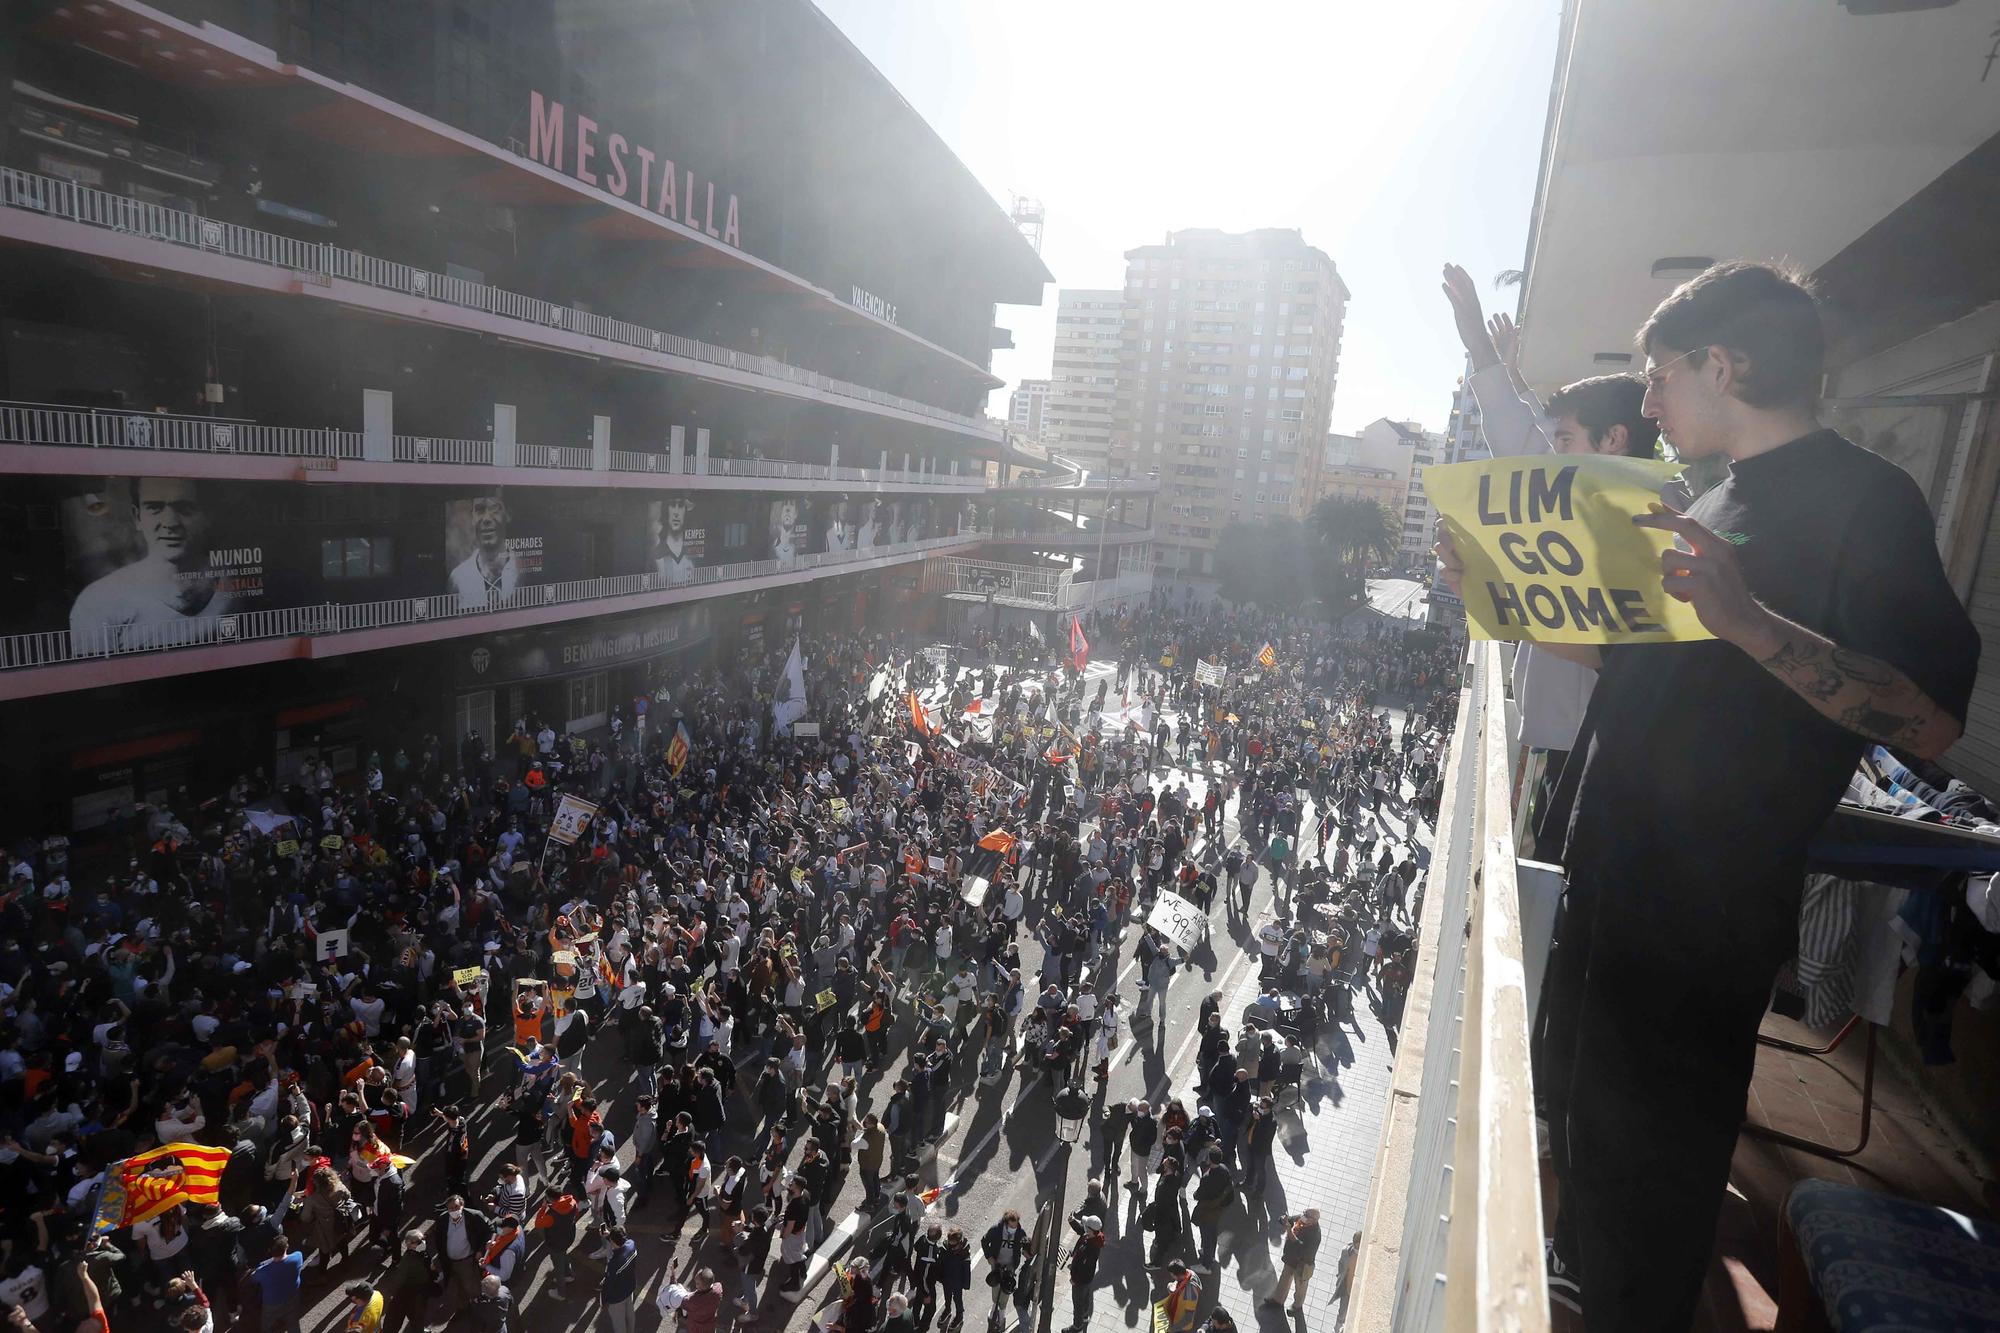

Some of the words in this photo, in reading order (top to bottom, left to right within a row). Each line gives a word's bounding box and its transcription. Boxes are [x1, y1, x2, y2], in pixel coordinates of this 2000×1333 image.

[528, 90, 741, 249] MESTALLA
[852, 284, 885, 318] VALENCIA
[1478, 465, 1579, 526] LIM
[684, 528, 705, 540] KEMPES
[209, 547, 262, 567] MUNDO
[1499, 530, 1585, 577] GO
[226, 568, 239, 577] AND
[239, 566, 263, 576] LEGEND
[1000, 576, 1010, 587] 52
[1486, 581, 1667, 633] HOME
[643, 627, 679, 648] MESTALLA
[1162, 892, 1182, 912] WE
